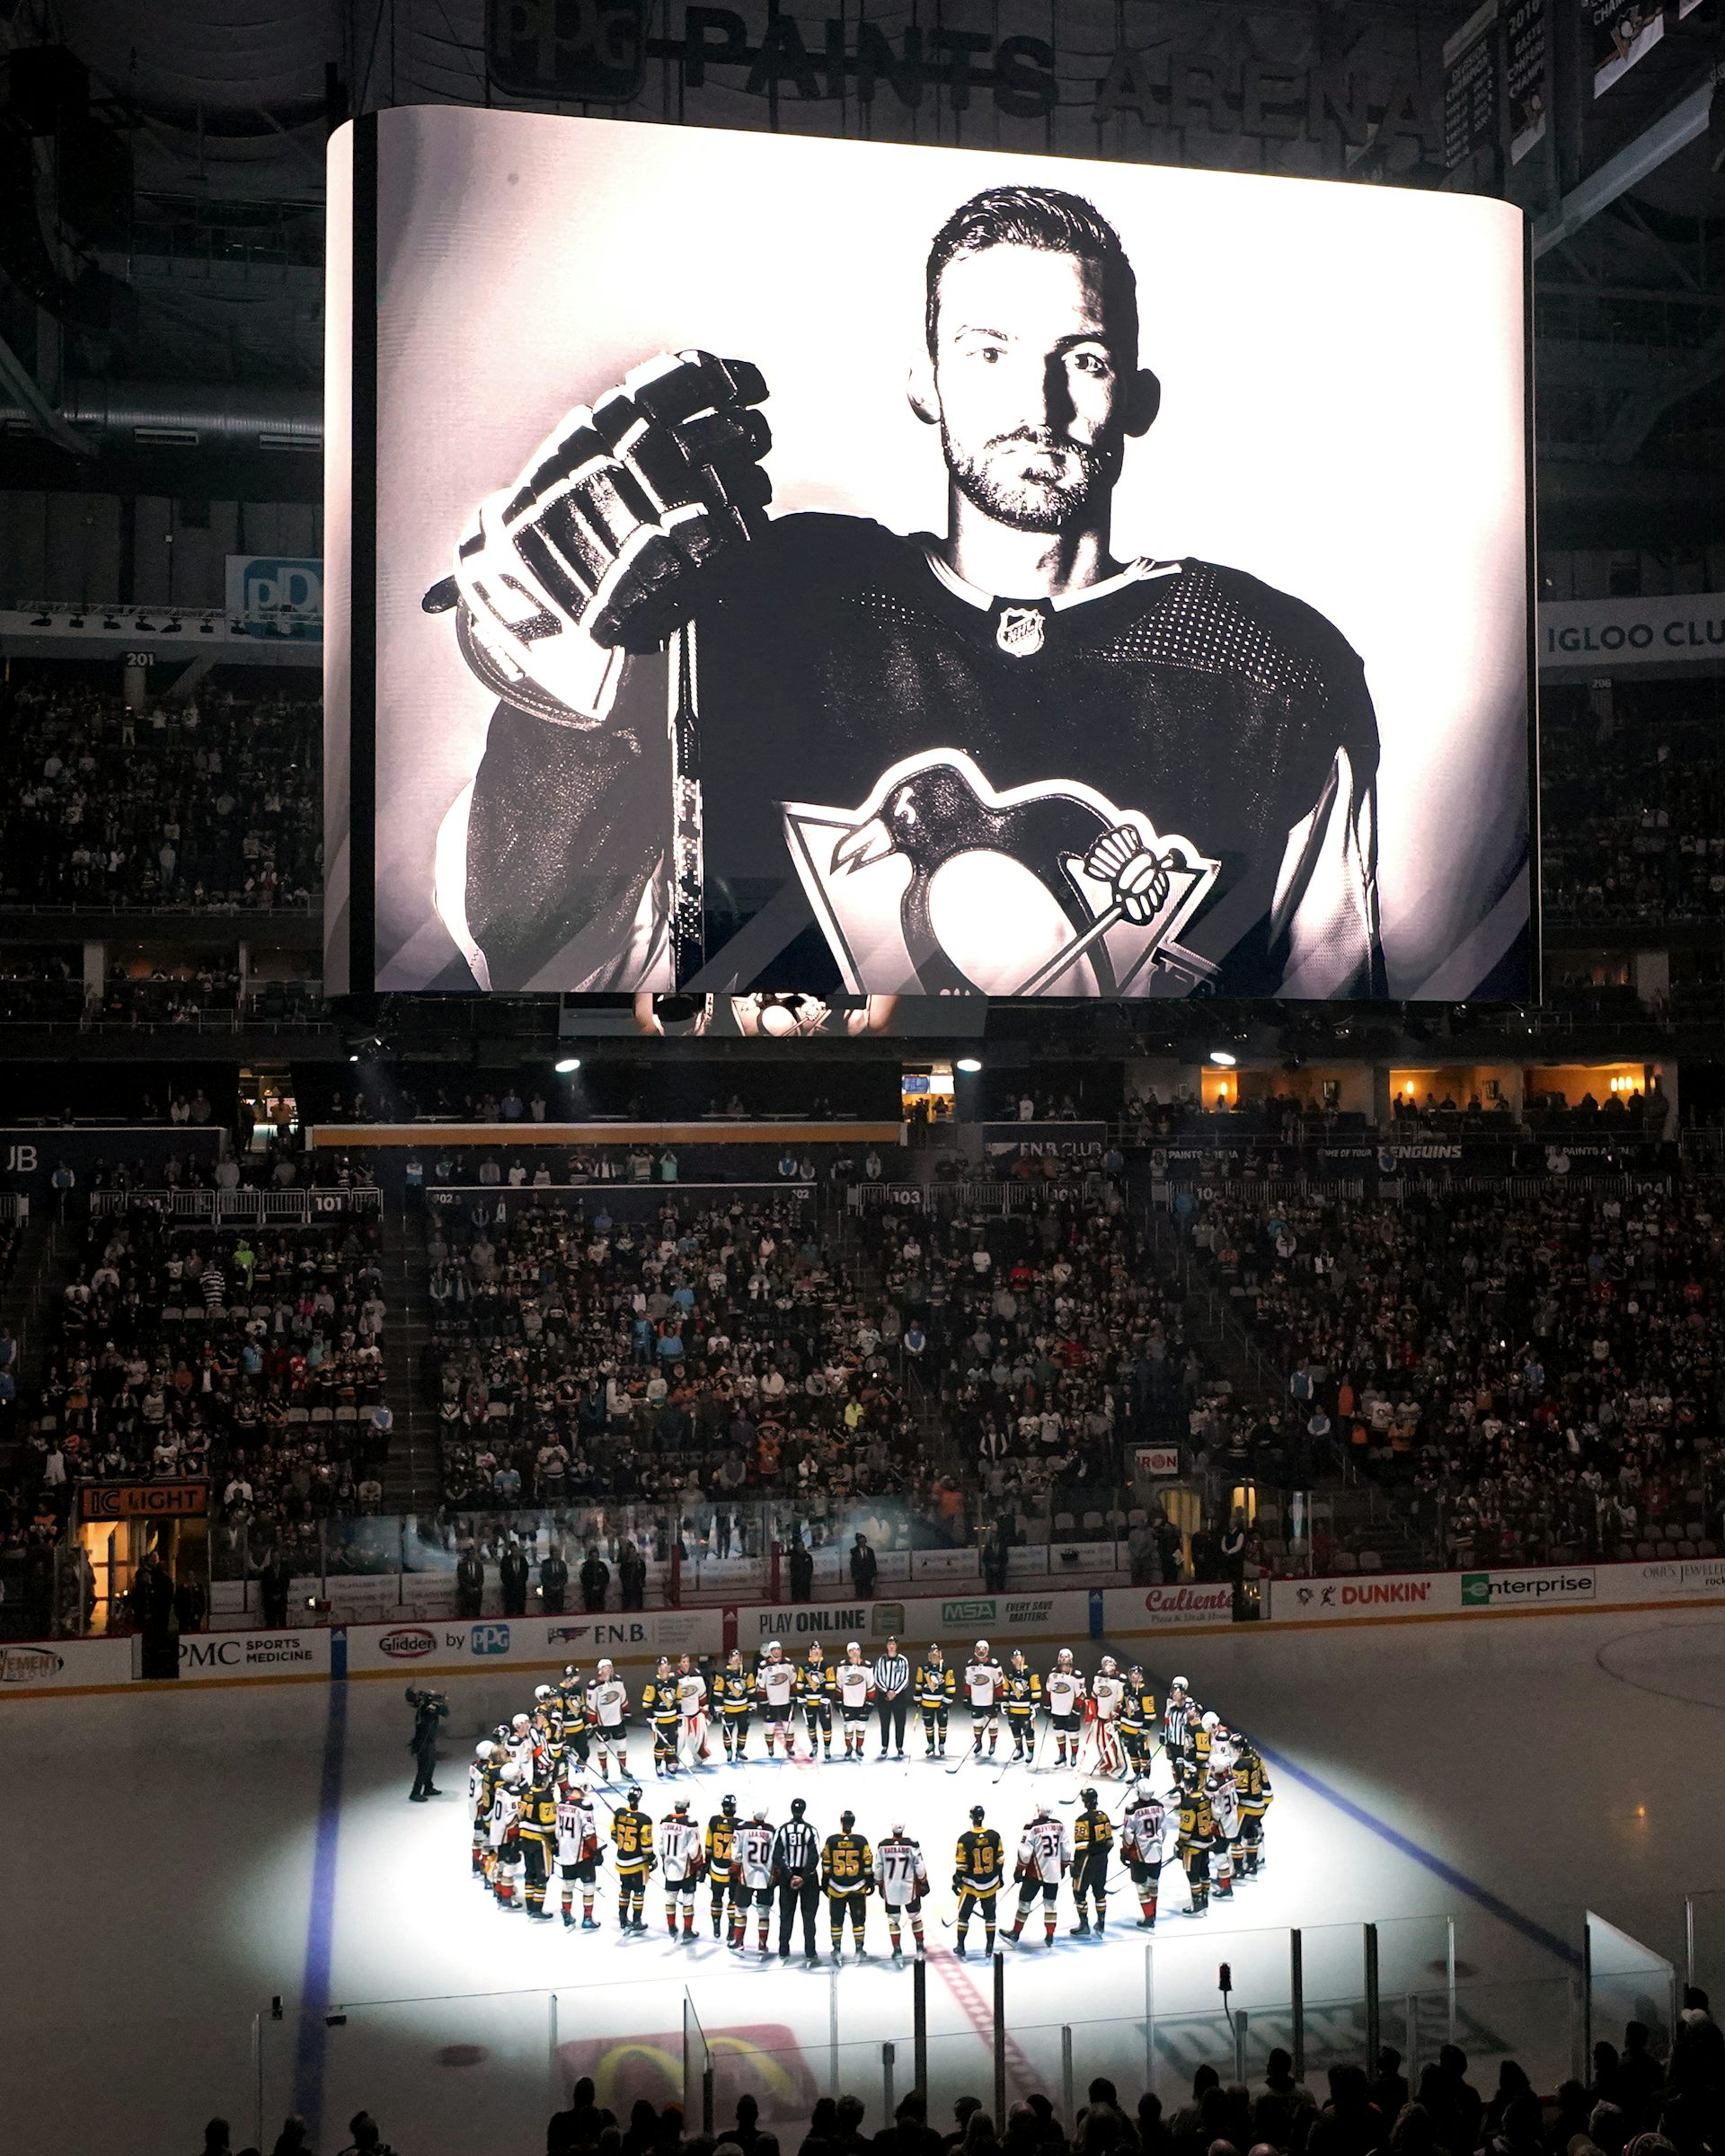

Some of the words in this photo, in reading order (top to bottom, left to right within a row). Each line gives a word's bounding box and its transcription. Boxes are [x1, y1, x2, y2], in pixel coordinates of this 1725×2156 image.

[686, 6, 1060, 118] PAINTS
[1093, 45, 1439, 154] ARENA
[1548, 623, 1653, 652] IGLOO
[126, 652, 154, 667] 201
[314, 1197, 342, 1212] 101
[893, 1190, 921, 1206] 103
[92, 1490, 119, 1515] IC
[128, 1489, 198, 1511] LIGHT
[1341, 1582, 1431, 1604] DUNKIN'
[1469, 1575, 1592, 1597] enterprise
[944, 1603, 995, 1620] MSA
[1005, 1602, 1031, 1612] EVERY
[1032, 1601, 1053, 1611] SAVE
[759, 1613, 792, 1635] PLAY
[796, 1609, 865, 1633] ONLINE
[246, 1638, 301, 1652] SPORTS
[379, 1636, 438, 1652] Glidden
[446, 1632, 465, 1649] by
[594, 1623, 647, 1645] F.N.B.
[246, 1650, 313, 1664] MEDICINE
[559, 1816, 575, 1838] 44
[616, 1824, 638, 1852] 65
[1143, 1816, 1158, 1839] 91
[667, 1833, 678, 1857] 11
[789, 1833, 802, 1846] 81
[748, 1841, 771, 1864] 20
[832, 1850, 860, 1877] 55
[973, 1846, 993, 1874] 19
[884, 1857, 910, 1879] 77
